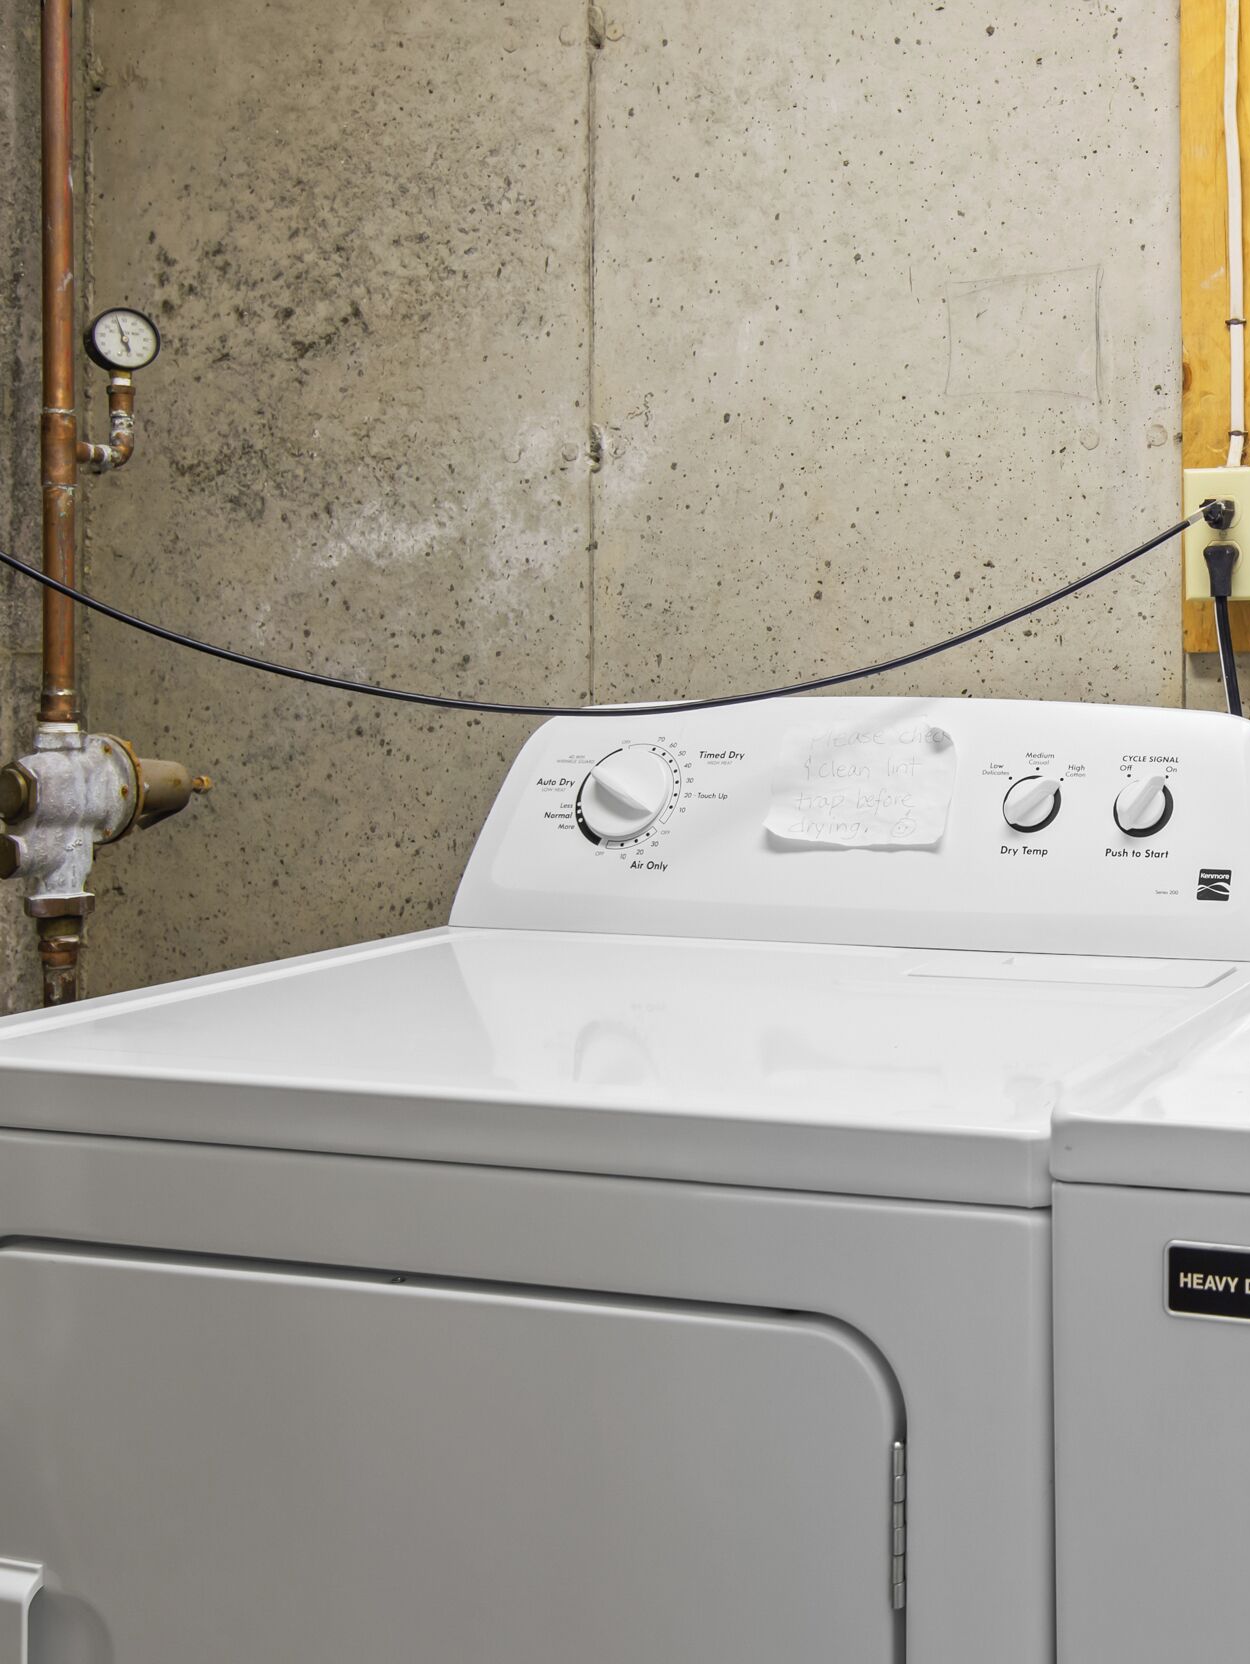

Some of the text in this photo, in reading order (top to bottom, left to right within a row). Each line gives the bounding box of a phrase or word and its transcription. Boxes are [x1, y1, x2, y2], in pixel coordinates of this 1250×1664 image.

[699, 750, 745, 760] Timed Dry
[1122, 755, 1147, 763] CYCLE
[1068, 764, 1085, 772] High
[536, 778, 576, 788] Auto Dry
[544, 811, 573, 819] Normal
[1000, 845, 1049, 857] Dry Temp
[1105, 848, 1169, 858] Push to Start
[630, 861, 668, 872] Air Only
[1200, 872, 1230, 880] Kenmore
[1179, 1272, 1239, 1293] HEAVY
